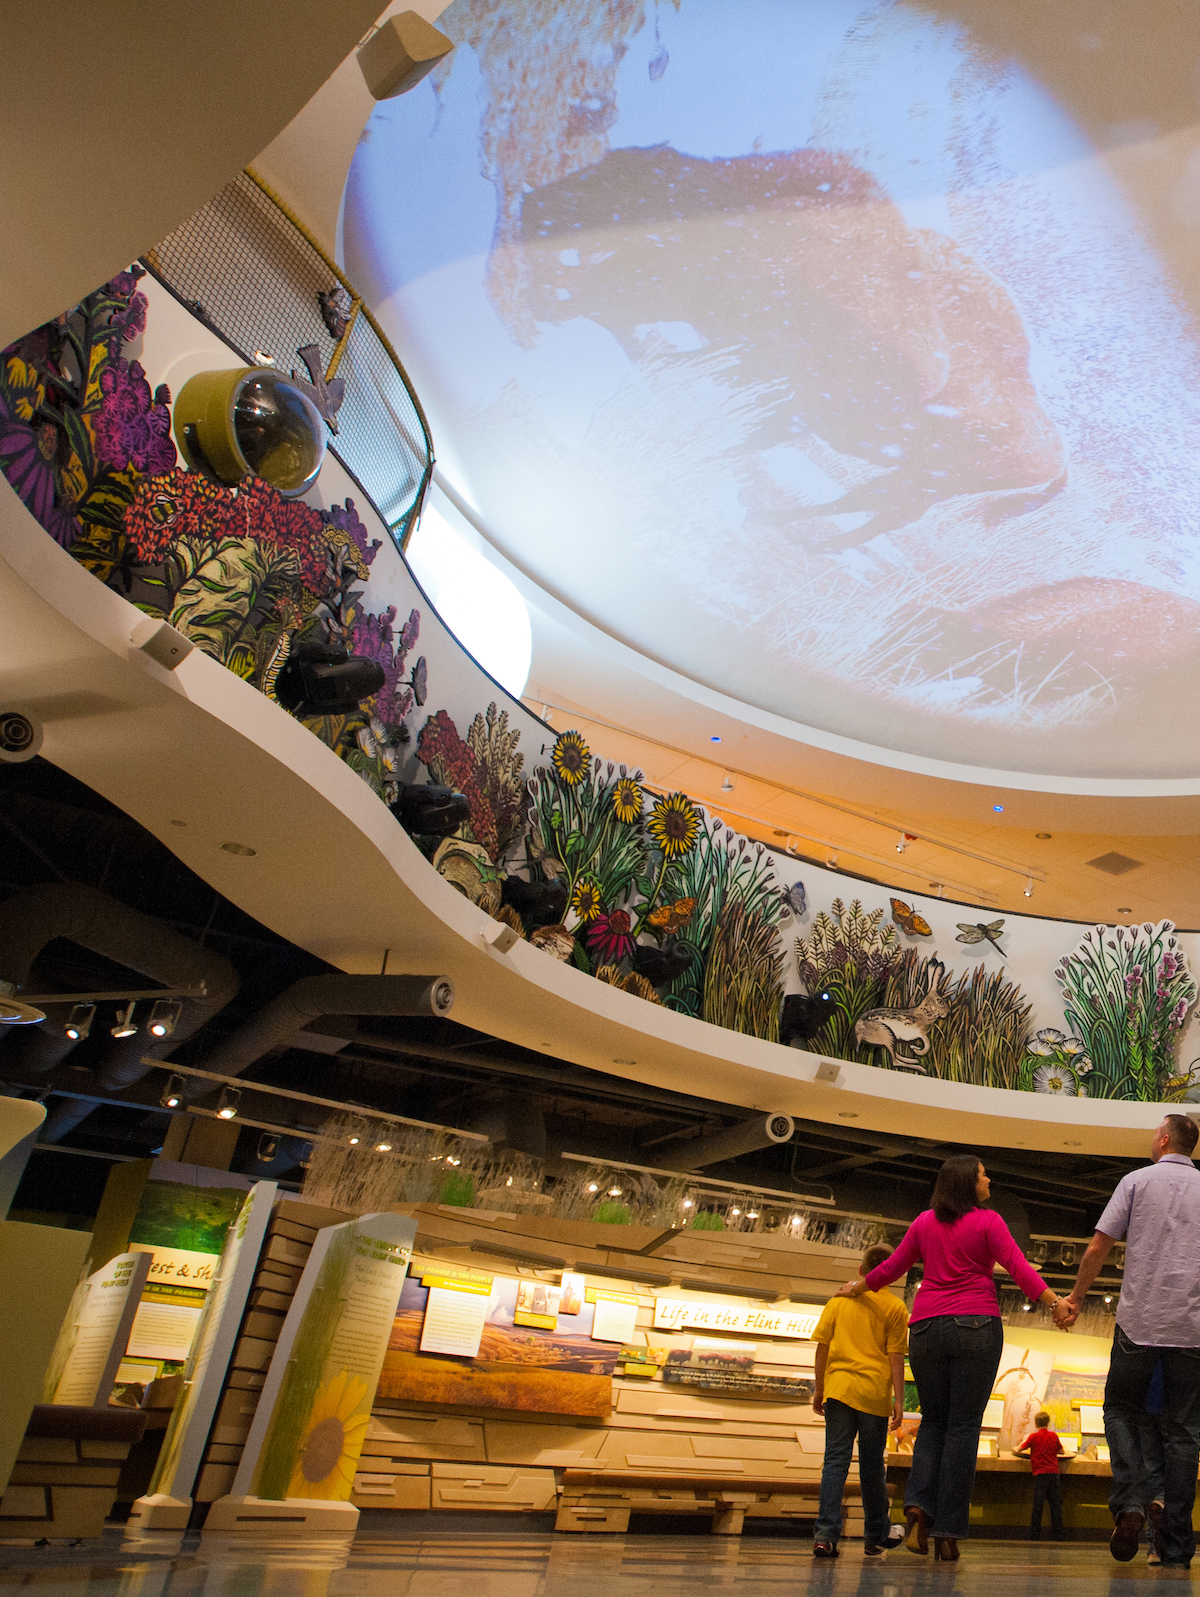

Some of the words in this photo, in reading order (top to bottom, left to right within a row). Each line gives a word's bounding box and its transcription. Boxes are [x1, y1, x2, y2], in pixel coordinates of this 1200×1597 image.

[177, 1263, 190, 1277] &
[414, 1264, 424, 1272] THE
[426, 1266, 451, 1275] PRAIRIE
[470, 1274, 492, 1283] PEOPLE
[660, 1305, 688, 1327] Life
[694, 1308, 709, 1323] in
[716, 1310, 739, 1326] the
[744, 1313, 782, 1330] Flint
[786, 1318, 815, 1333] Hill
